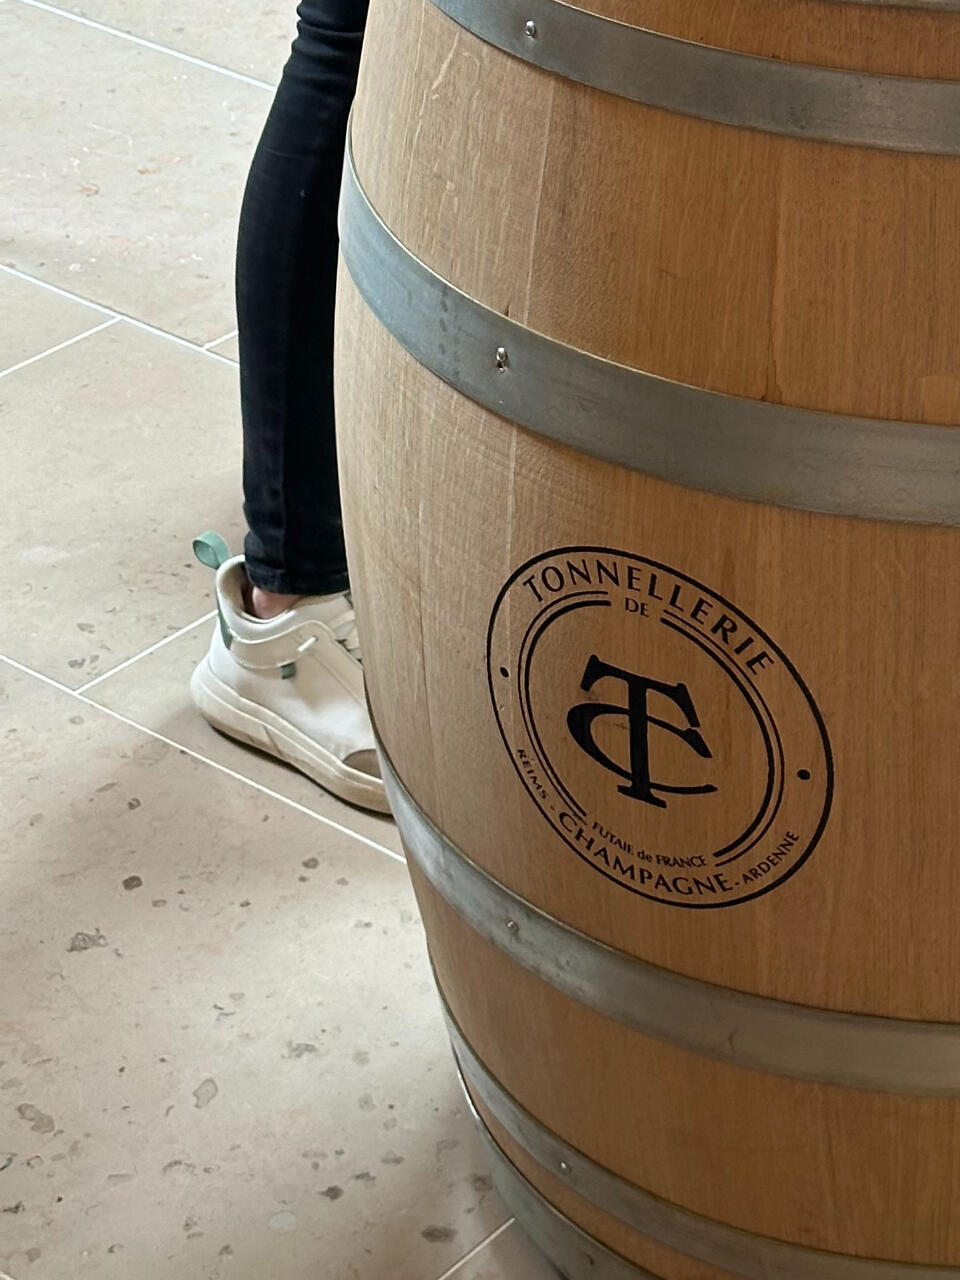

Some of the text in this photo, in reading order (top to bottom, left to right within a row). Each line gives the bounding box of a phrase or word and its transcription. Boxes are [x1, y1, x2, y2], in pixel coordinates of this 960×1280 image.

[522, 559, 775, 676] TONNELLERIE
[624, 597, 650, 617] DE
[516, 749, 548, 800] REIMS
[592, 822, 707, 868] FUTAIE de FRANCE
